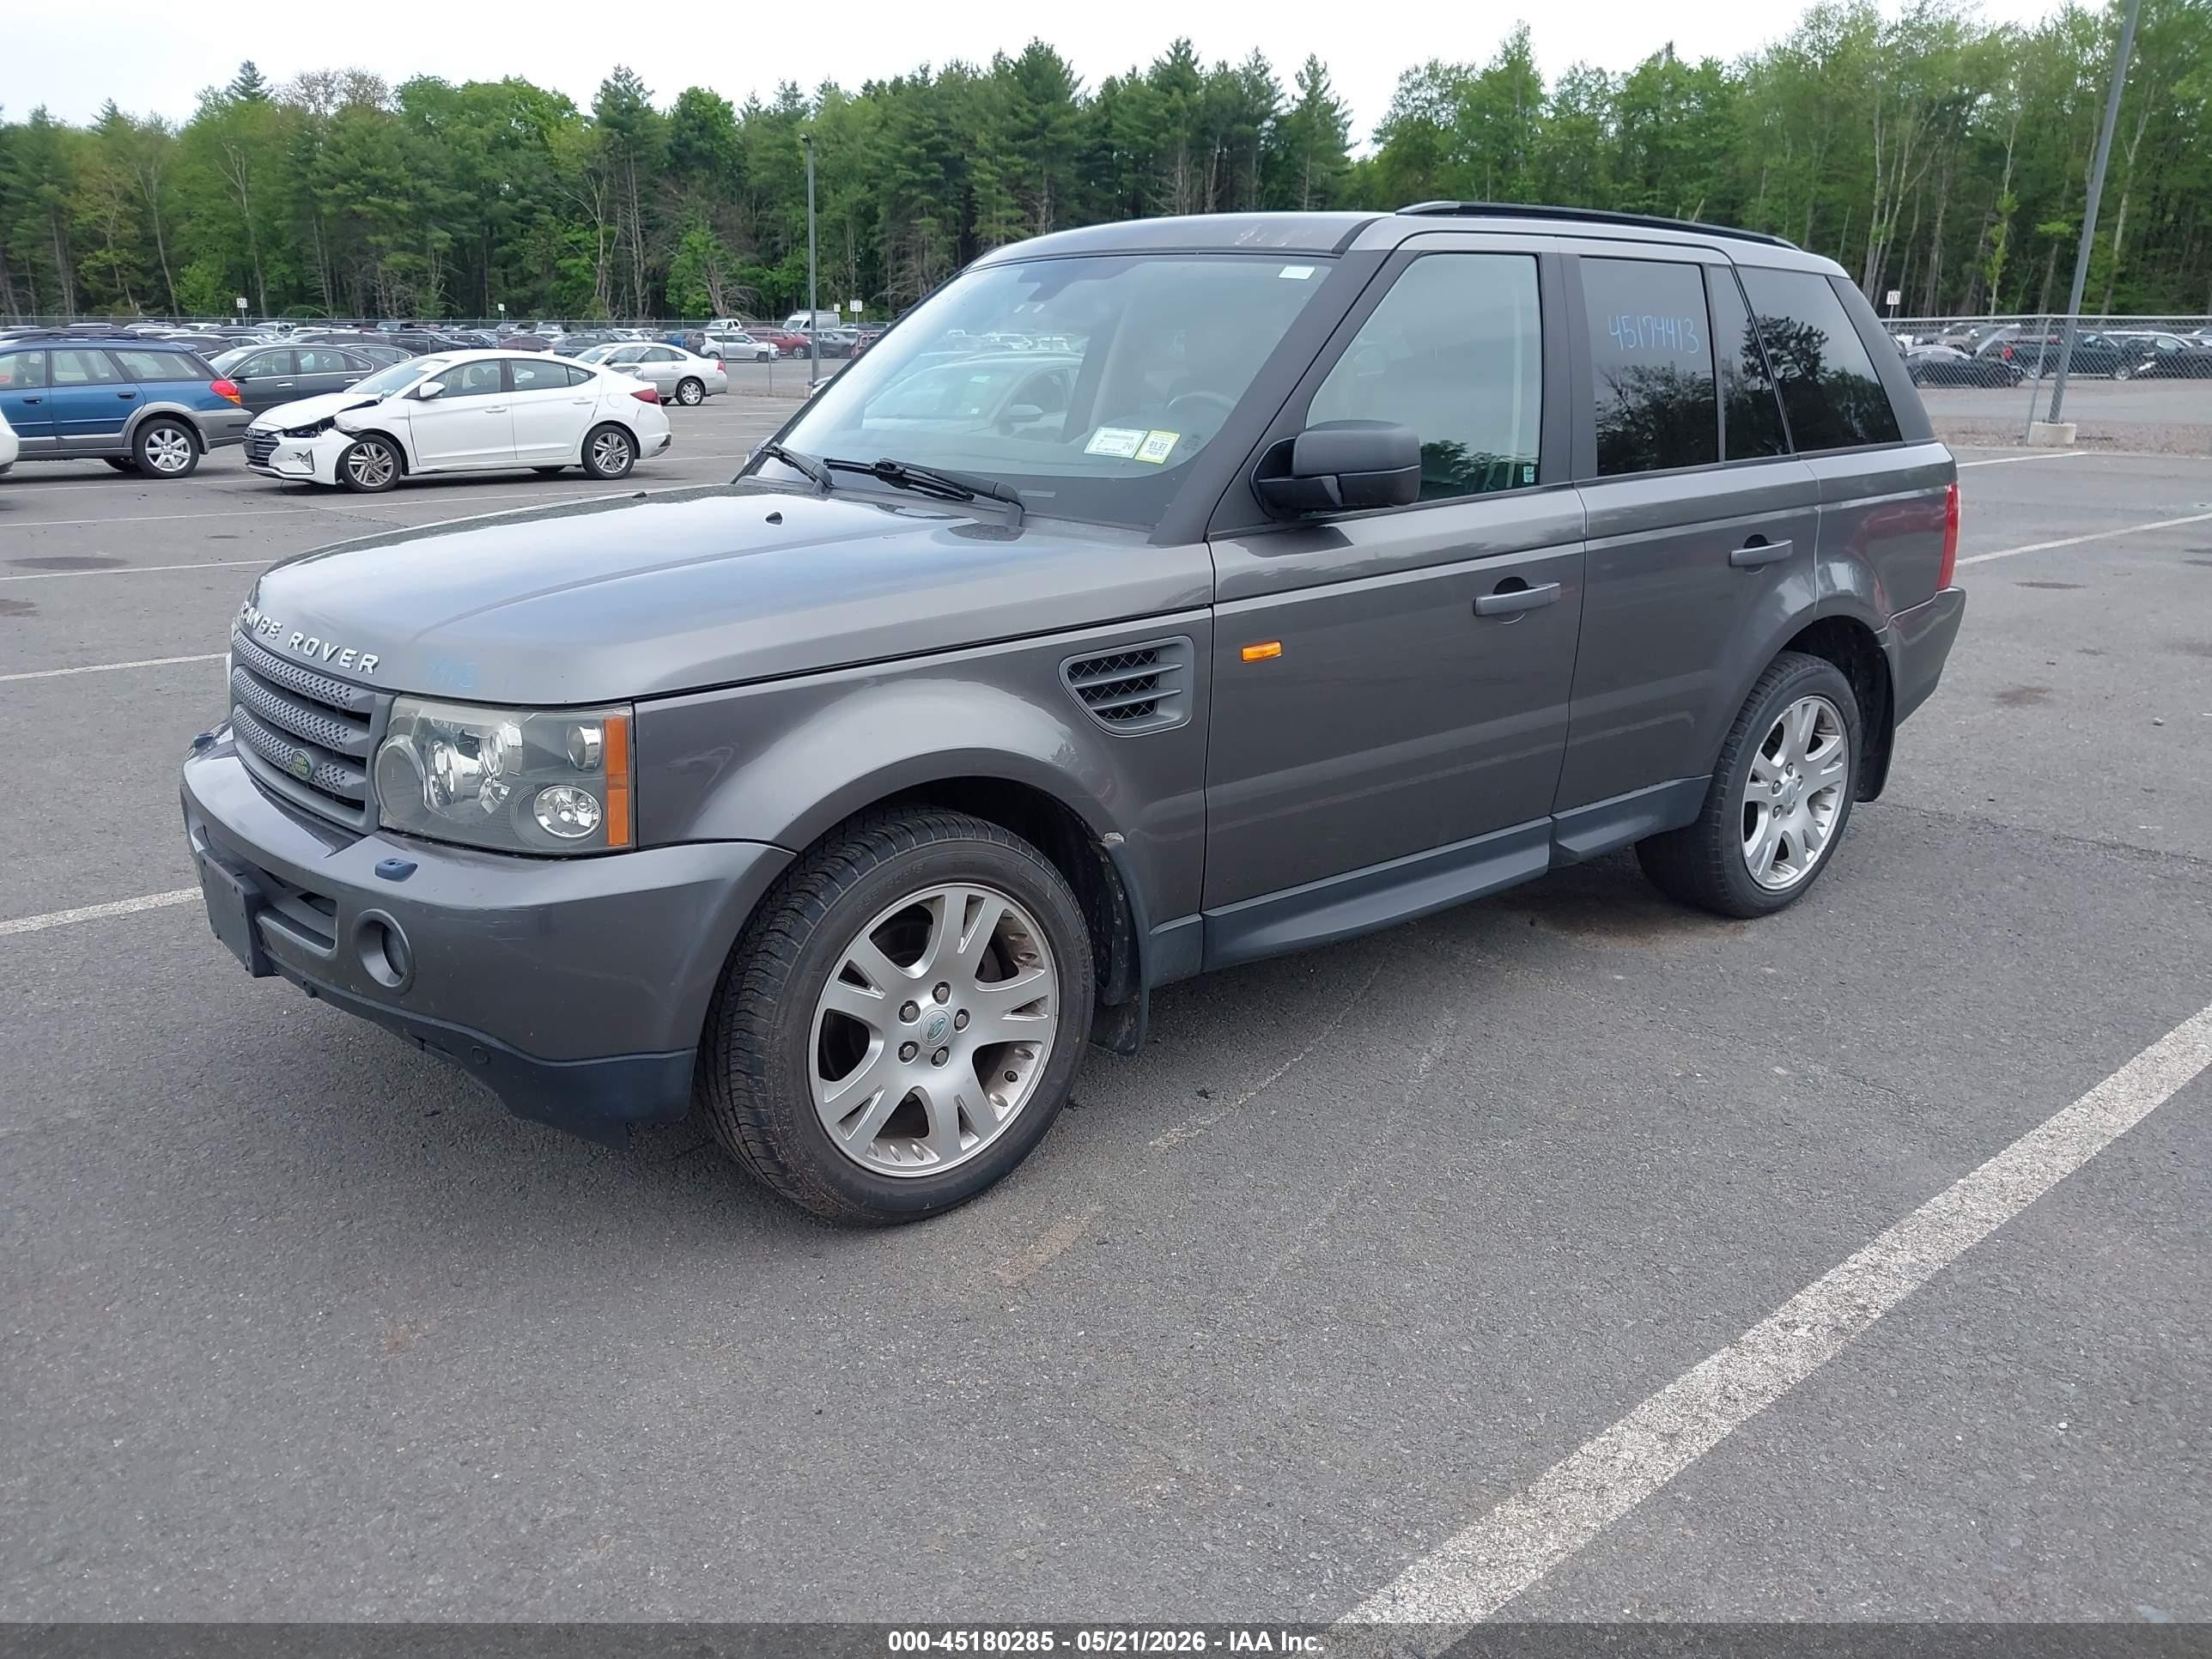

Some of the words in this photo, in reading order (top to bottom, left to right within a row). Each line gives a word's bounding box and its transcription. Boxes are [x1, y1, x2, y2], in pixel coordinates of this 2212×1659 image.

[1889, 293, 1899, 303] 10
[1608, 315, 1699, 354] 45174413
[289, 631, 379, 673] ROVER
